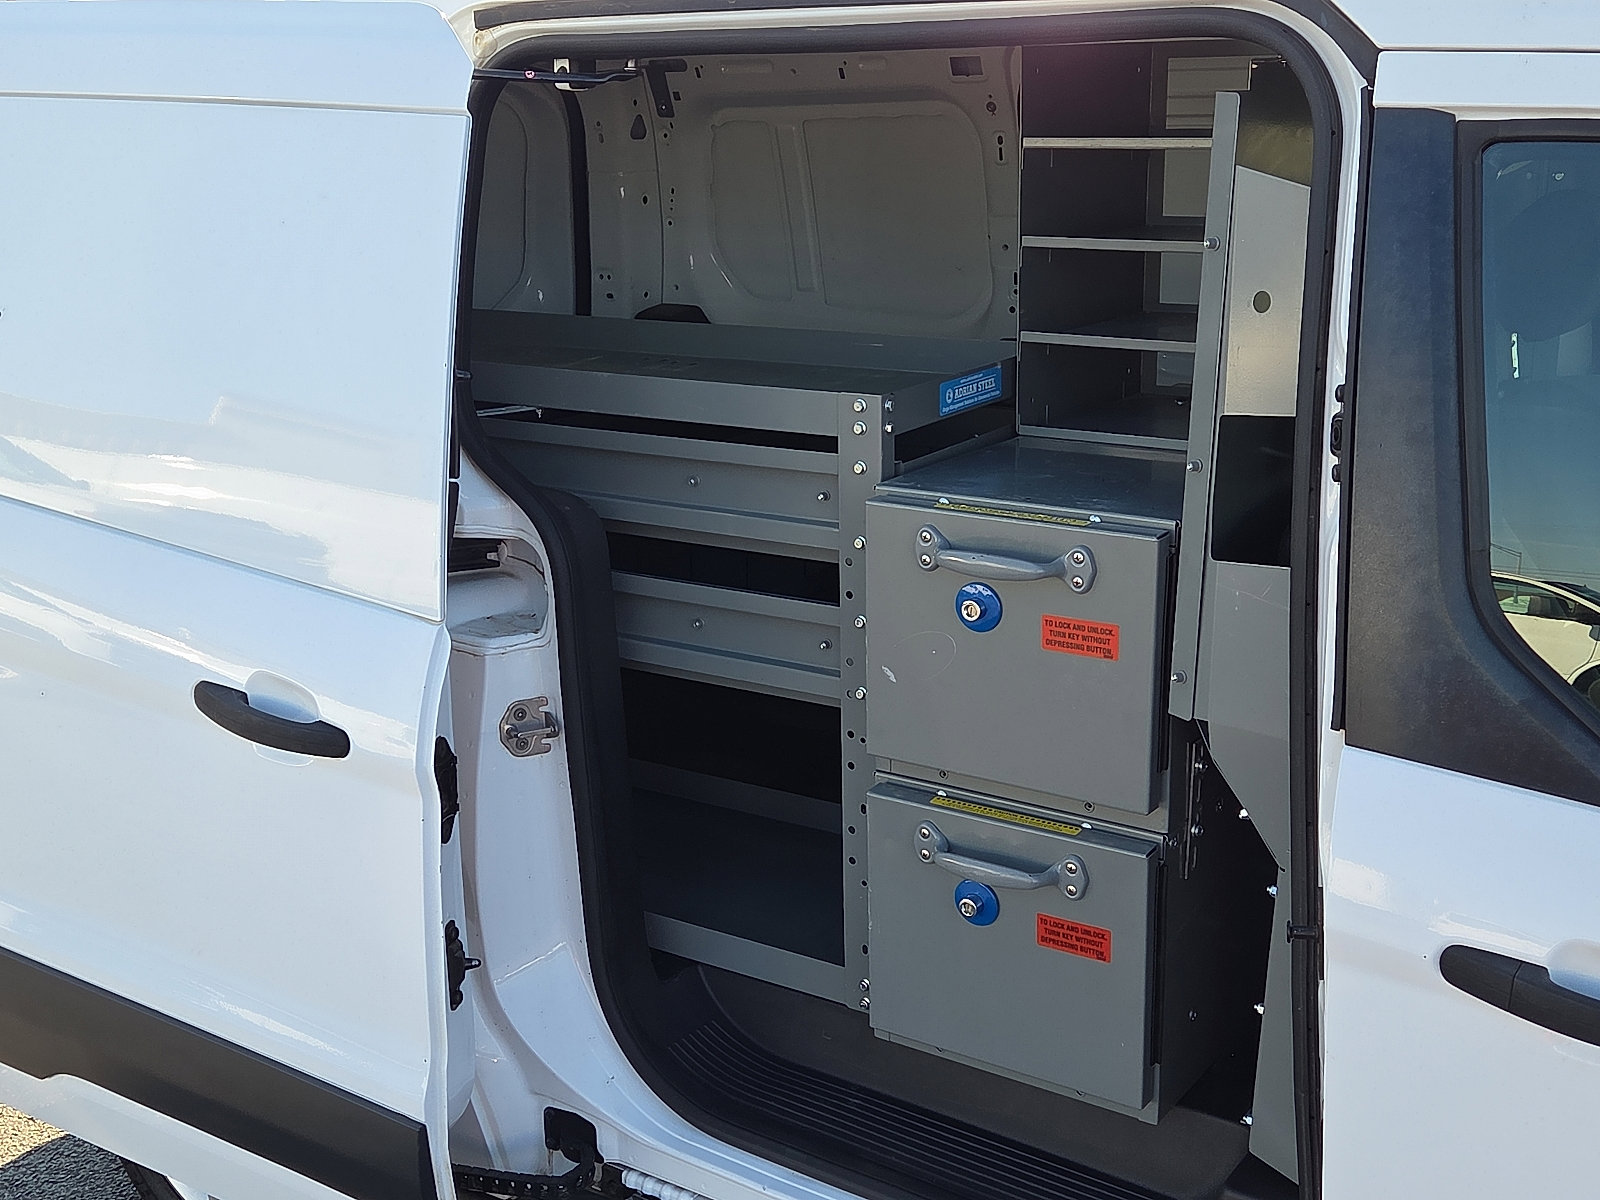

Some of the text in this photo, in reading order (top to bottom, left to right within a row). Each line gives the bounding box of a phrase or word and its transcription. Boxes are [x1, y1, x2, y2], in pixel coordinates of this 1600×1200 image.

[954, 383, 978, 400] ADRIAN
[978, 378, 996, 392] STEEL
[1045, 619, 1053, 627] TO
[1055, 620, 1071, 630] LOCK
[1072, 624, 1086, 632] AND
[1045, 638, 1085, 651] DEPRESSING
[1049, 629, 1111, 646] TURN KEY WITHOUT
[1049, 920, 1065, 930] LOCK
[1066, 924, 1079, 933] AND
[1040, 935, 1079, 951] DEPRESSING
[1044, 927, 1104, 948] TURN KEY WITHOUT
